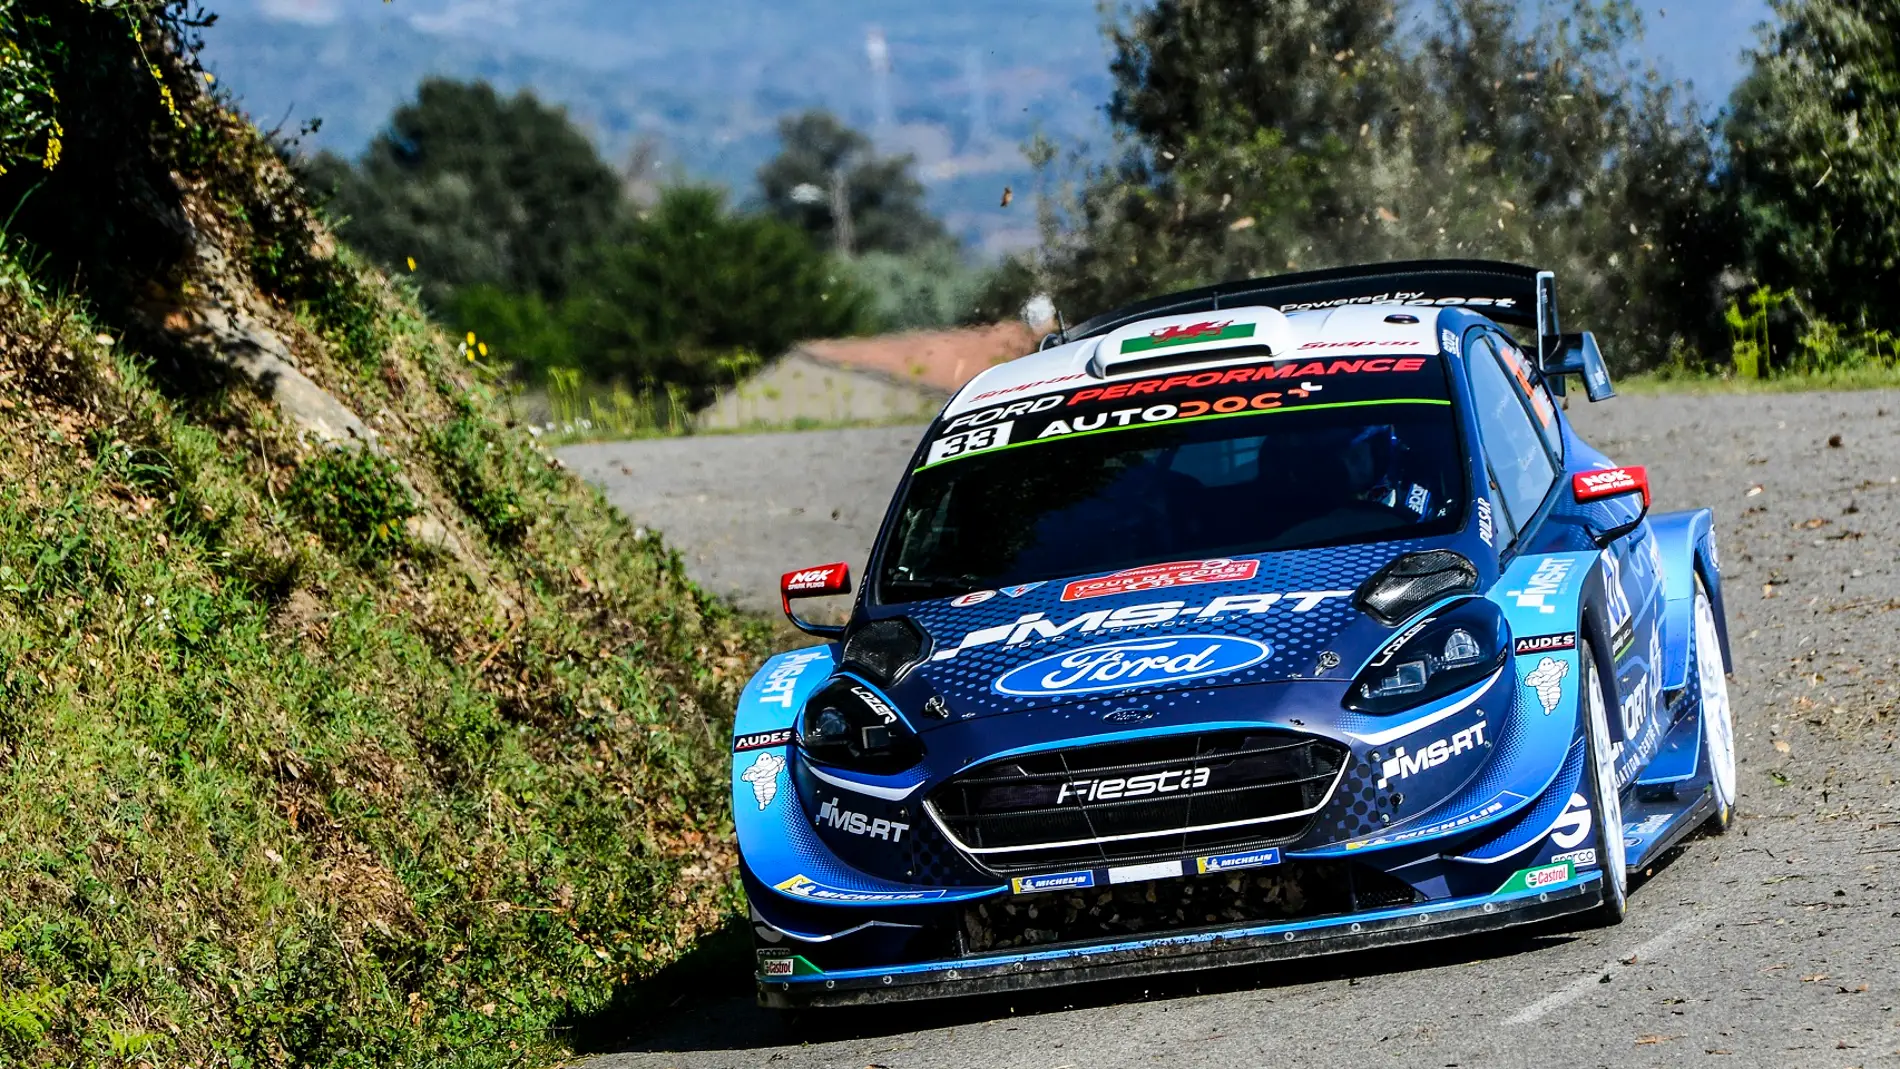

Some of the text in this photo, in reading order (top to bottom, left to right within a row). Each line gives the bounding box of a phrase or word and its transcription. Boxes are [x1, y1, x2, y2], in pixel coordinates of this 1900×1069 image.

[1280, 291, 1424, 313] Powered by
[1297, 341, 1420, 350] Snap-on
[943, 358, 1427, 435] FORD PERFORMANCE
[969, 373, 1087, 402] Snap-on
[940, 426, 1001, 459] 33
[1581, 469, 1632, 487] NGK
[1478, 497, 1493, 548] PULSAR
[789, 569, 834, 584] NGK
[1075, 577, 1134, 592] TOUR
[1143, 572, 1175, 583] DE
[1178, 565, 1249, 579] CORSE
[1009, 588, 1354, 647] MS-RT
[1002, 614, 1243, 651] ROAD TECHNOLOGY
[1516, 634, 1575, 651] AUDES
[1041, 640, 1222, 689] Ford
[1619, 672, 1648, 740] ORT
[735, 728, 792, 748] AUDES
[1400, 720, 1487, 779] MS-RT
[1056, 766, 1211, 805] Fiesta
[828, 810, 910, 843] MS-RT
[1397, 802, 1503, 842] MICHELIN
[1221, 853, 1273, 867] MICHELIN
[1035, 876, 1087, 888] MICHELIN
[1537, 866, 1567, 885] Castrol
[814, 889, 925, 900] MICHELIN
[768, 960, 792, 975] Castrol
